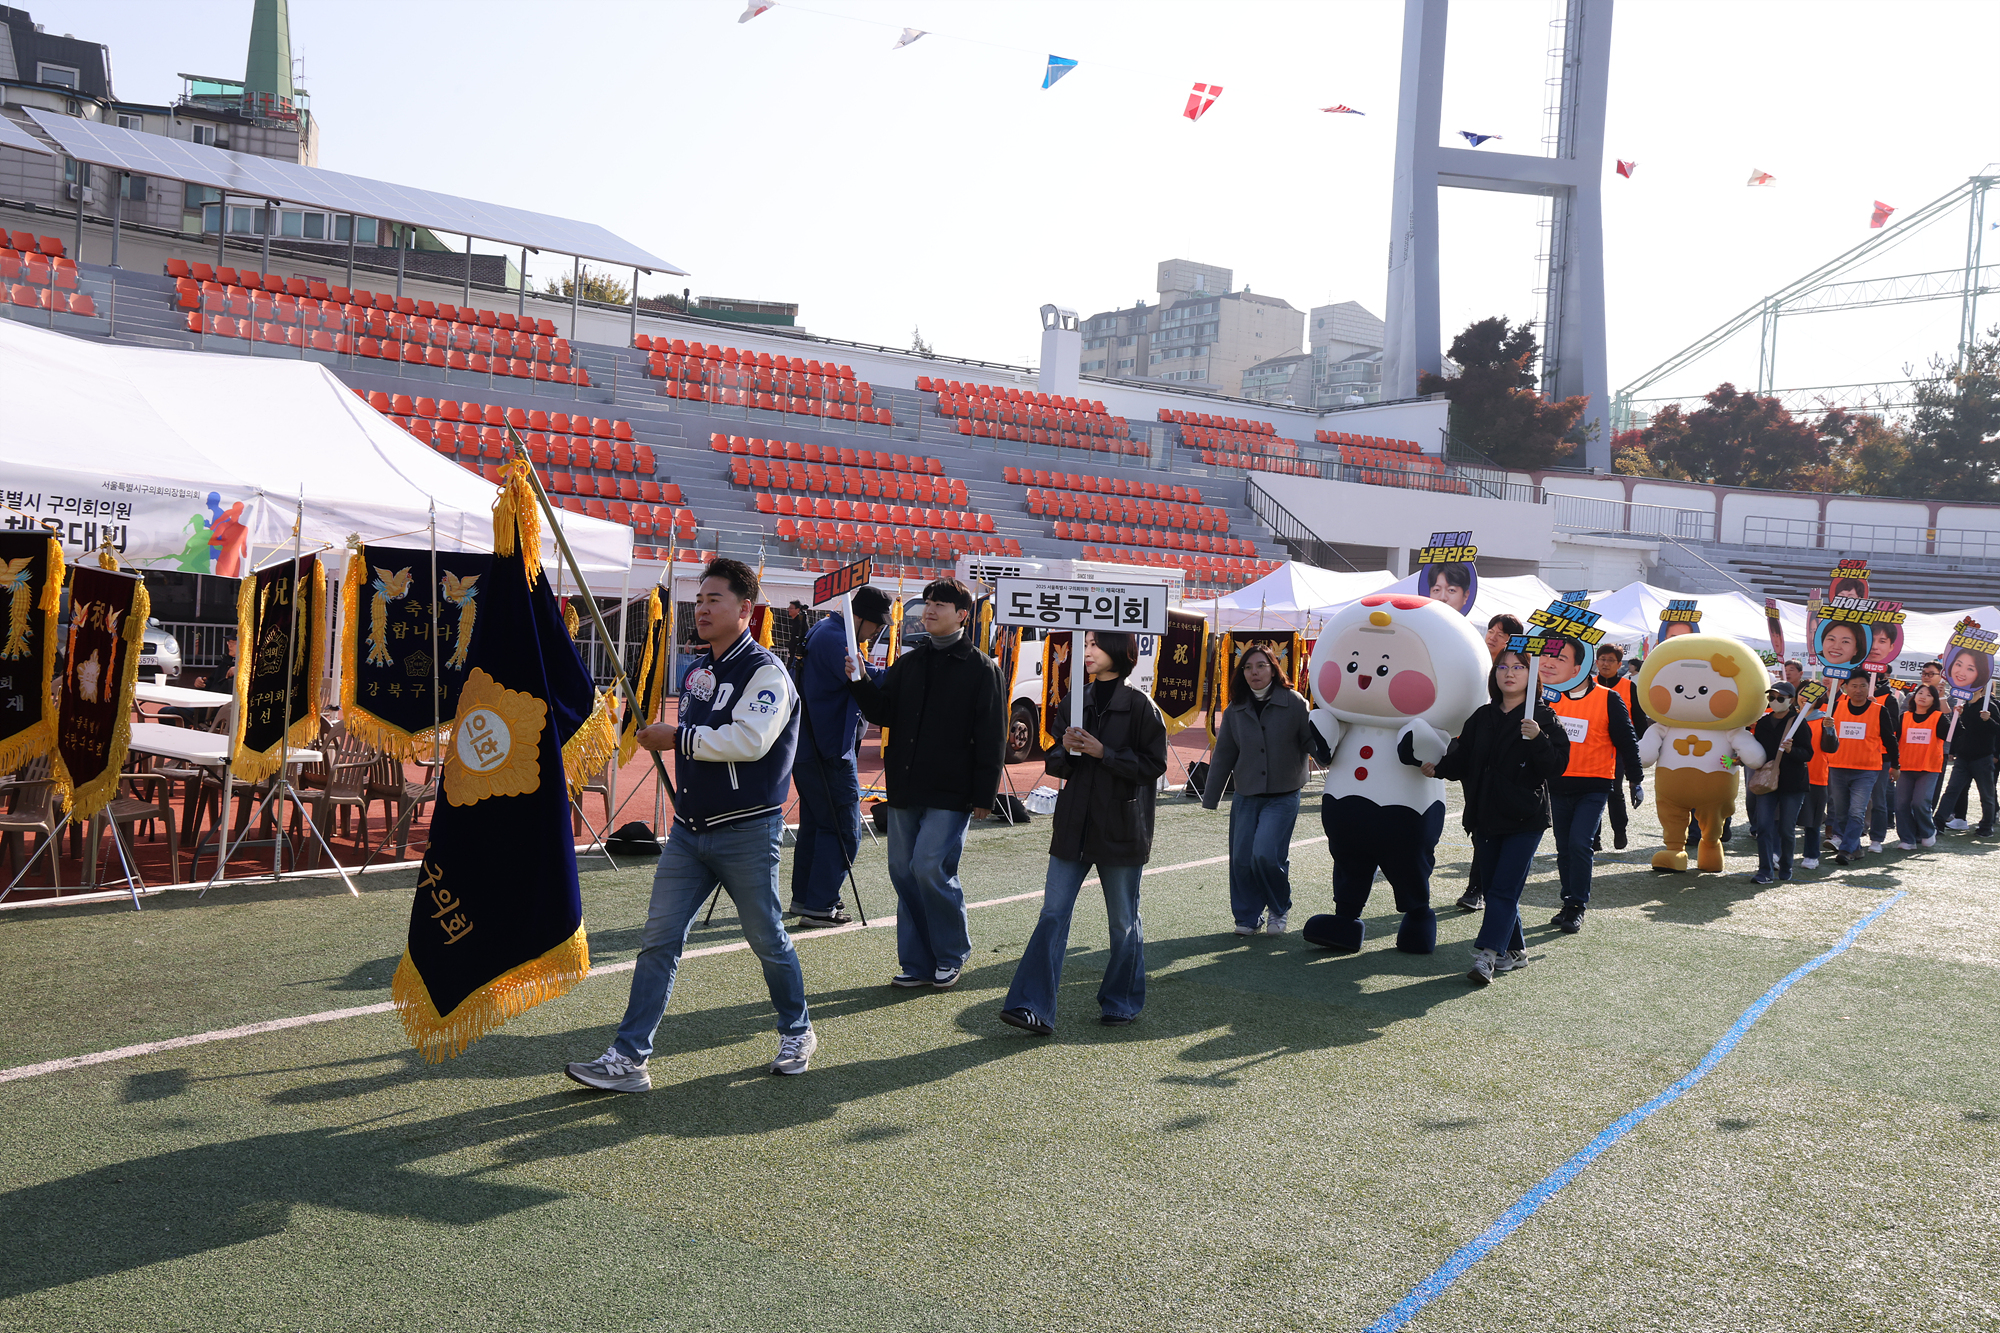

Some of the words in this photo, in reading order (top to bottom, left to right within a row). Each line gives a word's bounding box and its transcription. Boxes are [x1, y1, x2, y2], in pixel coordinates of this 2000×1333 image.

[101, 480, 200, 500] 서울특별시구의회의장협의회
[0, 490, 41, 513] 별시
[47, 495, 132, 521] 구의회의원
[1430, 531, 1472, 547] 레벨이
[1418, 545, 1477, 563] 남달라요
[1830, 568, 1871, 579] 승리한다
[1838, 559, 1867, 569] 우리가
[814, 558, 871, 604] 힘내라
[404, 600, 444, 617] 축하
[1008, 591, 1149, 629] 도봉구의회
[1546, 600, 1601, 627] 끝까지
[1668, 600, 1697, 610] 싸워서
[1830, 597, 1877, 612] 파이팅!
[1660, 610, 1702, 622] 이길태용
[1817, 606, 1877, 625] 도봉의회
[1874, 610, 1906, 624] 네요
[392, 622, 453, 641] 합니다
[1527, 610, 1606, 645] 포기못해
[1963, 626, 1998, 642] 잠깐만
[1173, 643, 1188, 665] 祝
[1507, 636, 1564, 656] 짝짝짝
[1951, 634, 2000, 655] 타임타임
[712, 683, 734, 711] D
[1800, 682, 1827, 703] 짝
[6, 695, 23, 711] 재
[748, 702, 778, 715] 도봉구
[465, 713, 505, 769] 의회
